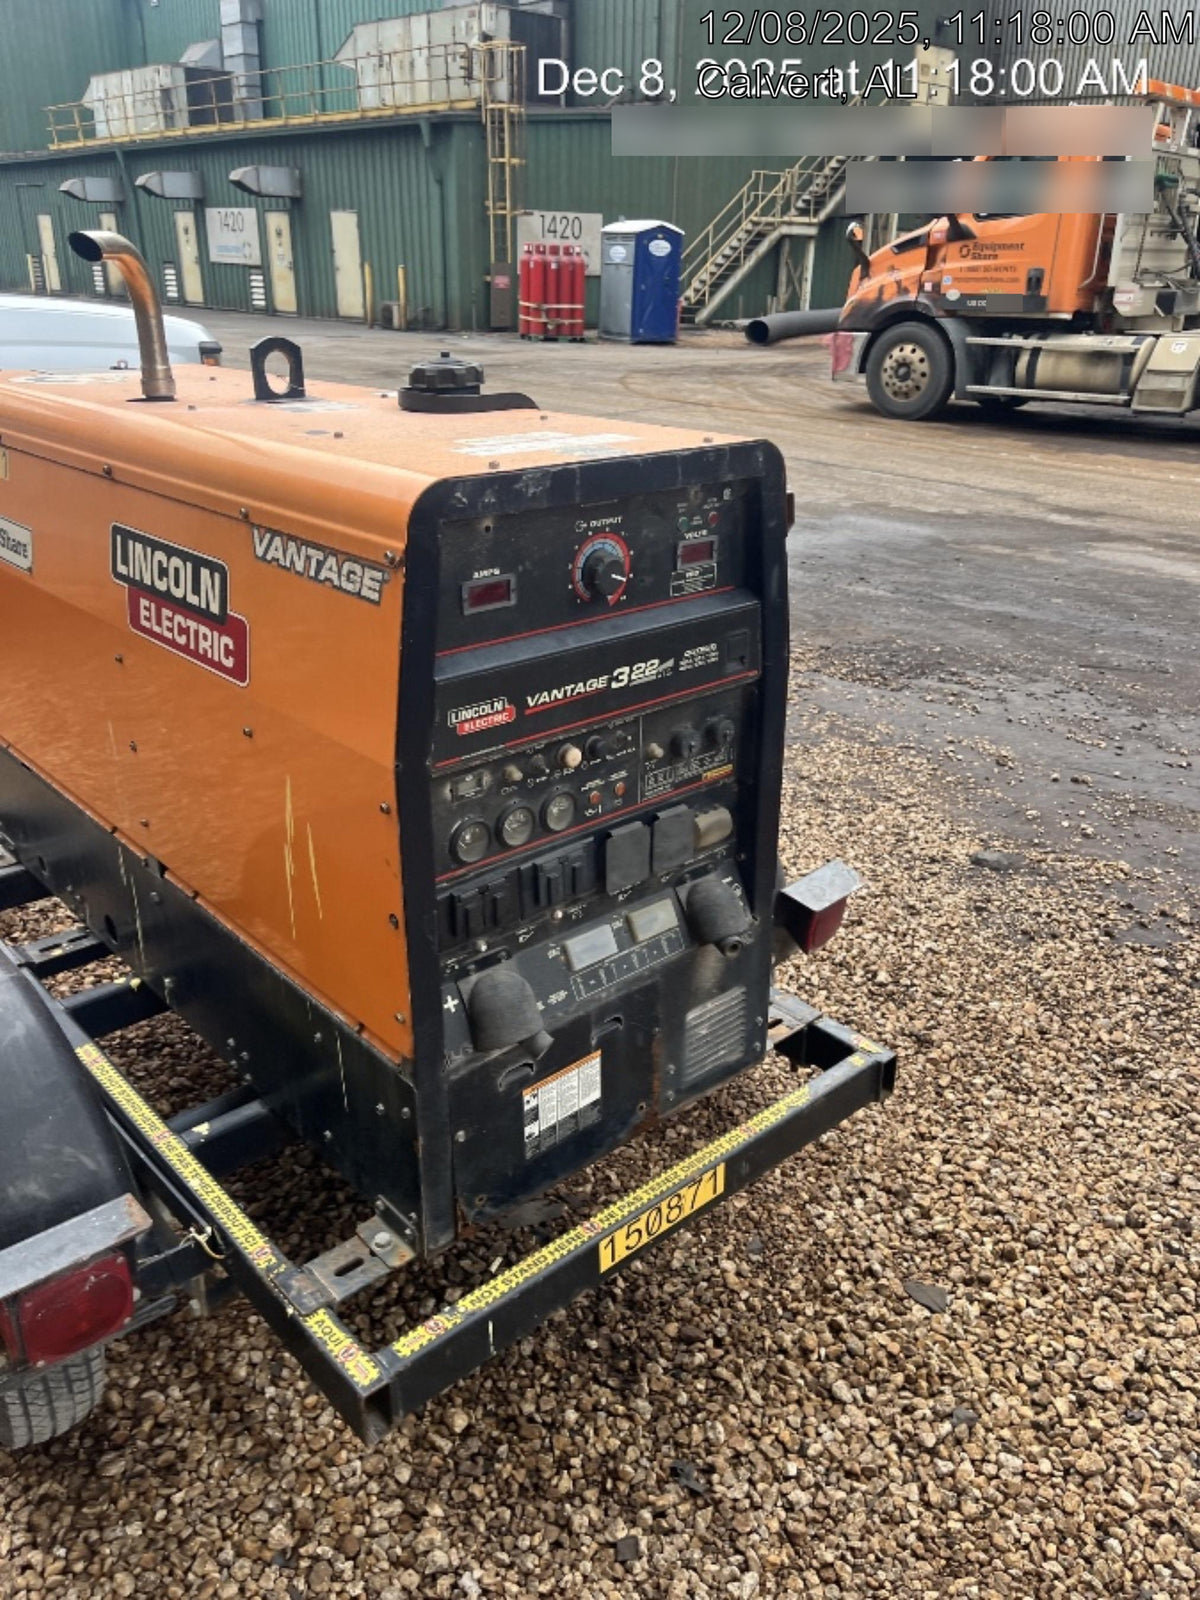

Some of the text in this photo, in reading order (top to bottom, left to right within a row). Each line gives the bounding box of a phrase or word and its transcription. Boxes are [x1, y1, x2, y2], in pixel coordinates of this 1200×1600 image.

[218, 211, 244, 232] 1420
[540, 214, 582, 240] 1420
[0, 528, 28, 559] Share
[115, 534, 222, 616] LINCOLN
[253, 527, 384, 603] VANTAGE
[139, 597, 235, 668] ELECTRIC
[526, 674, 609, 708] VANTAGE
[611, 659, 660, 689] 322
[450, 700, 506, 724] LINCOLN
[463, 711, 511, 732] ELECTRIC
[213, 1195, 248, 1231] DEBOUT
[604, 1168, 718, 1263] 150871
[469, 1283, 500, 1307] NOT
[501, 1254, 548, 1286] STAND
[313, 1318, 344, 1348] AQUI
